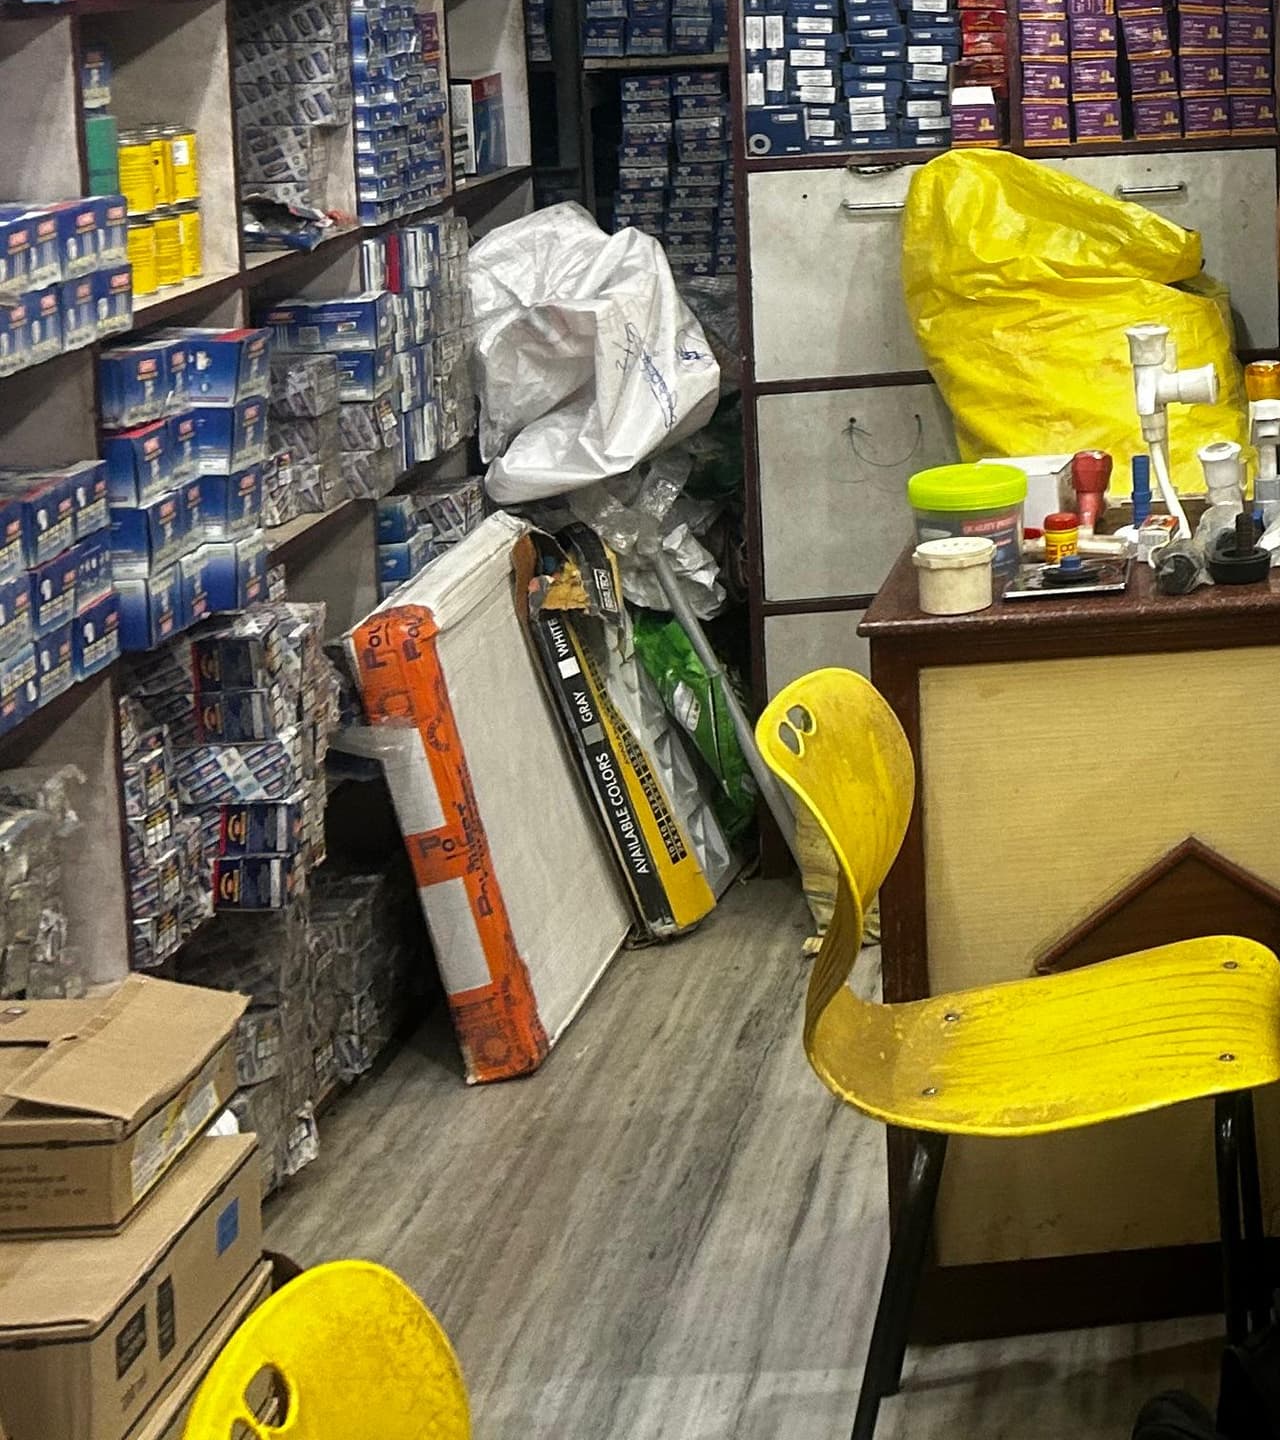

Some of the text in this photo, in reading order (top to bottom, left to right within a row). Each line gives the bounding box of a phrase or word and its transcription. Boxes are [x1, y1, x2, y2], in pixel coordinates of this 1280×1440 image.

[573, 691, 592, 722] GRAY
[596, 752, 624, 807] COLORS
[616, 805, 649, 874] AVAILABLE
